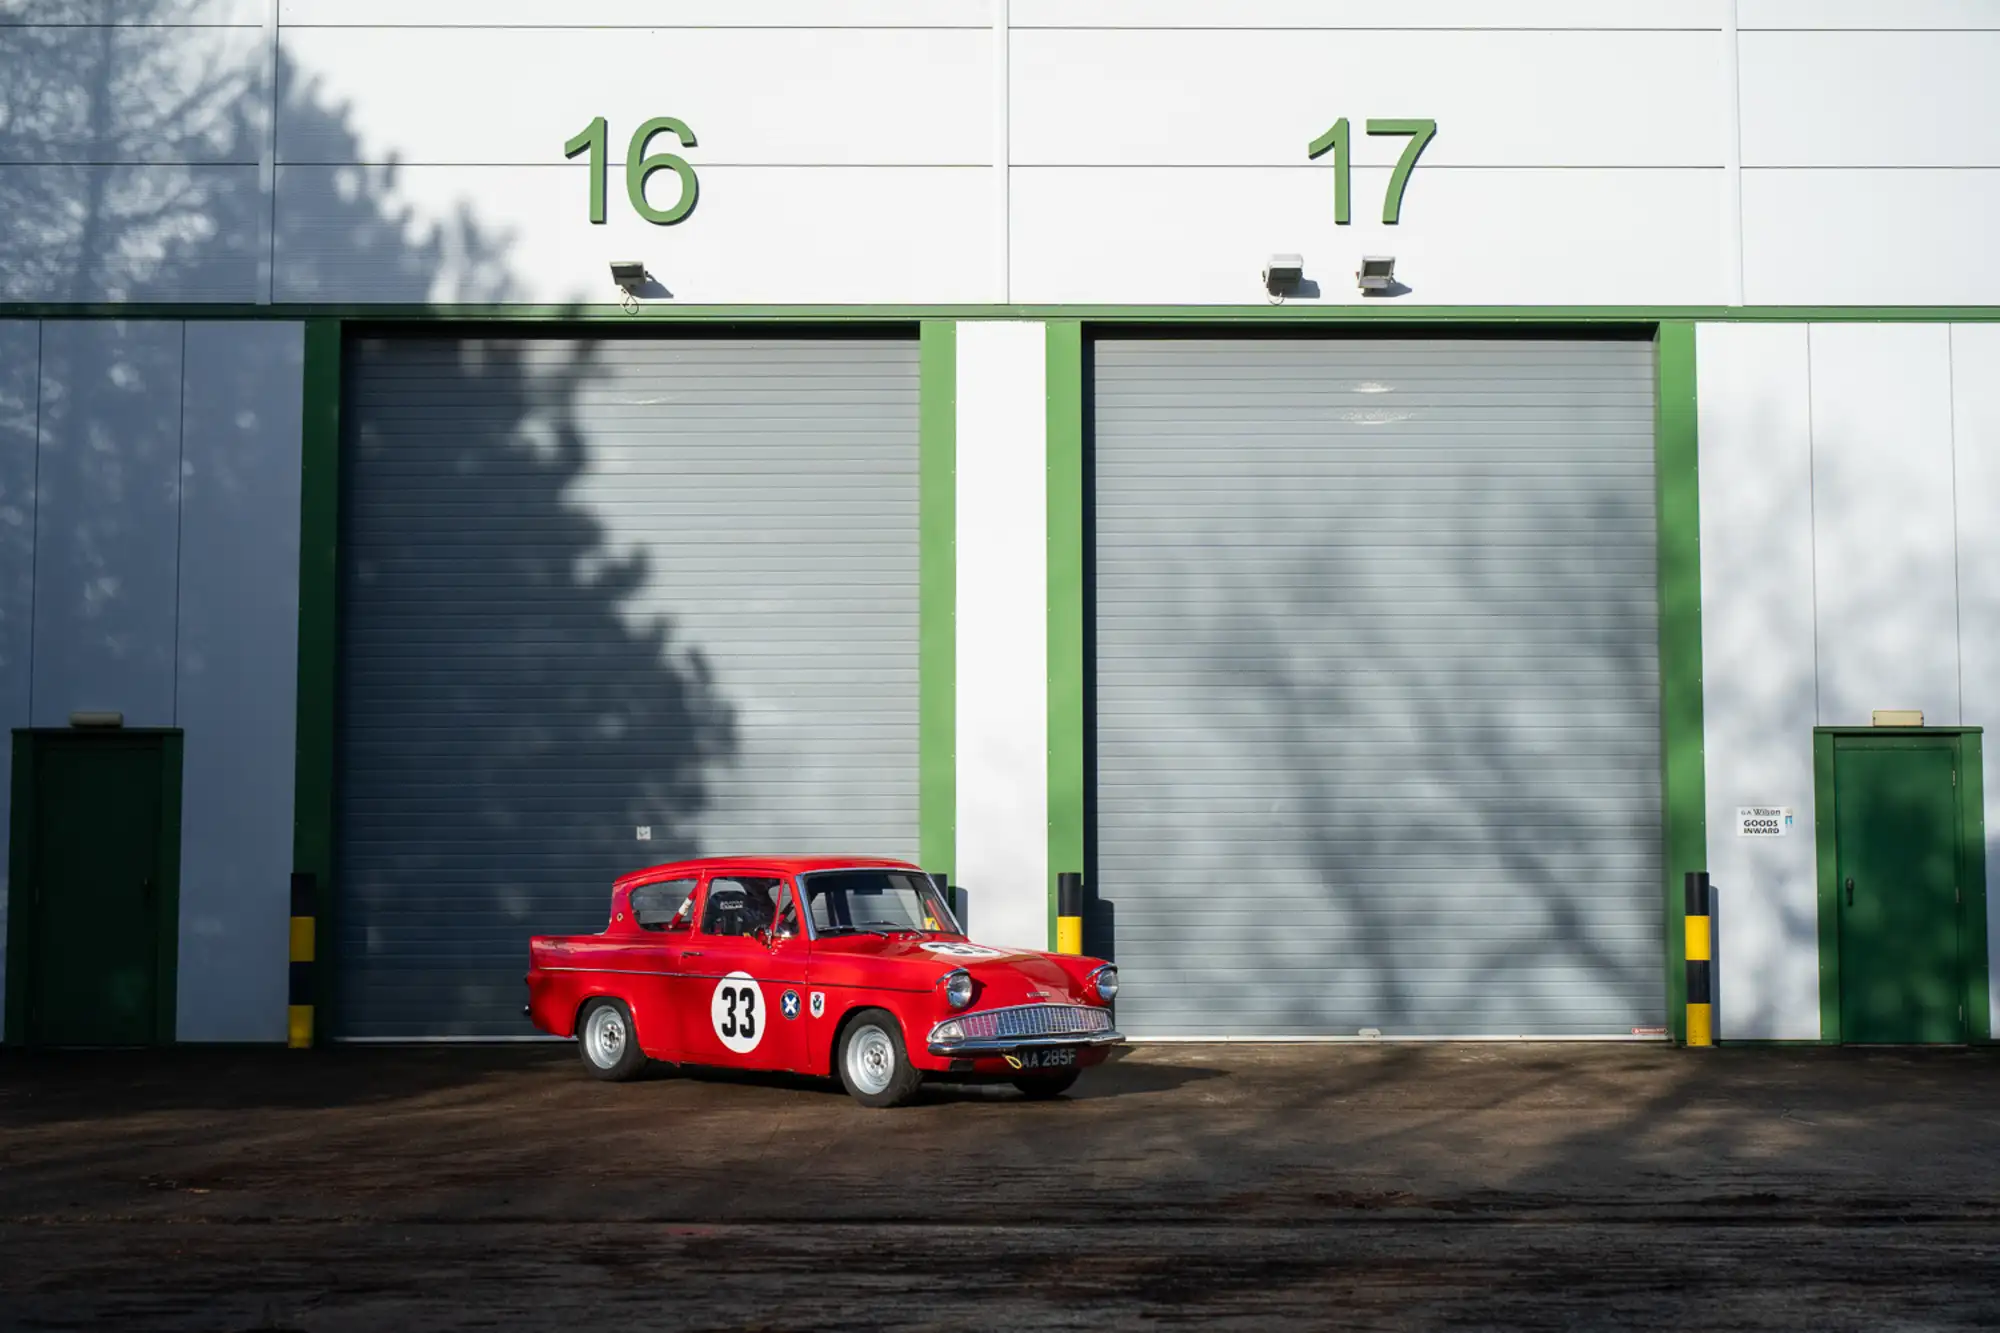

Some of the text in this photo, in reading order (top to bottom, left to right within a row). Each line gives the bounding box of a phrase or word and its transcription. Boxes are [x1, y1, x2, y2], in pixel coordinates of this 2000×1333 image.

[564, 116, 699, 226] 16
[1308, 117, 1437, 225] 17
[1743, 819, 1778, 827] GOODS
[722, 987, 755, 1038] 33
[1042, 1048, 1076, 1067] 285F
